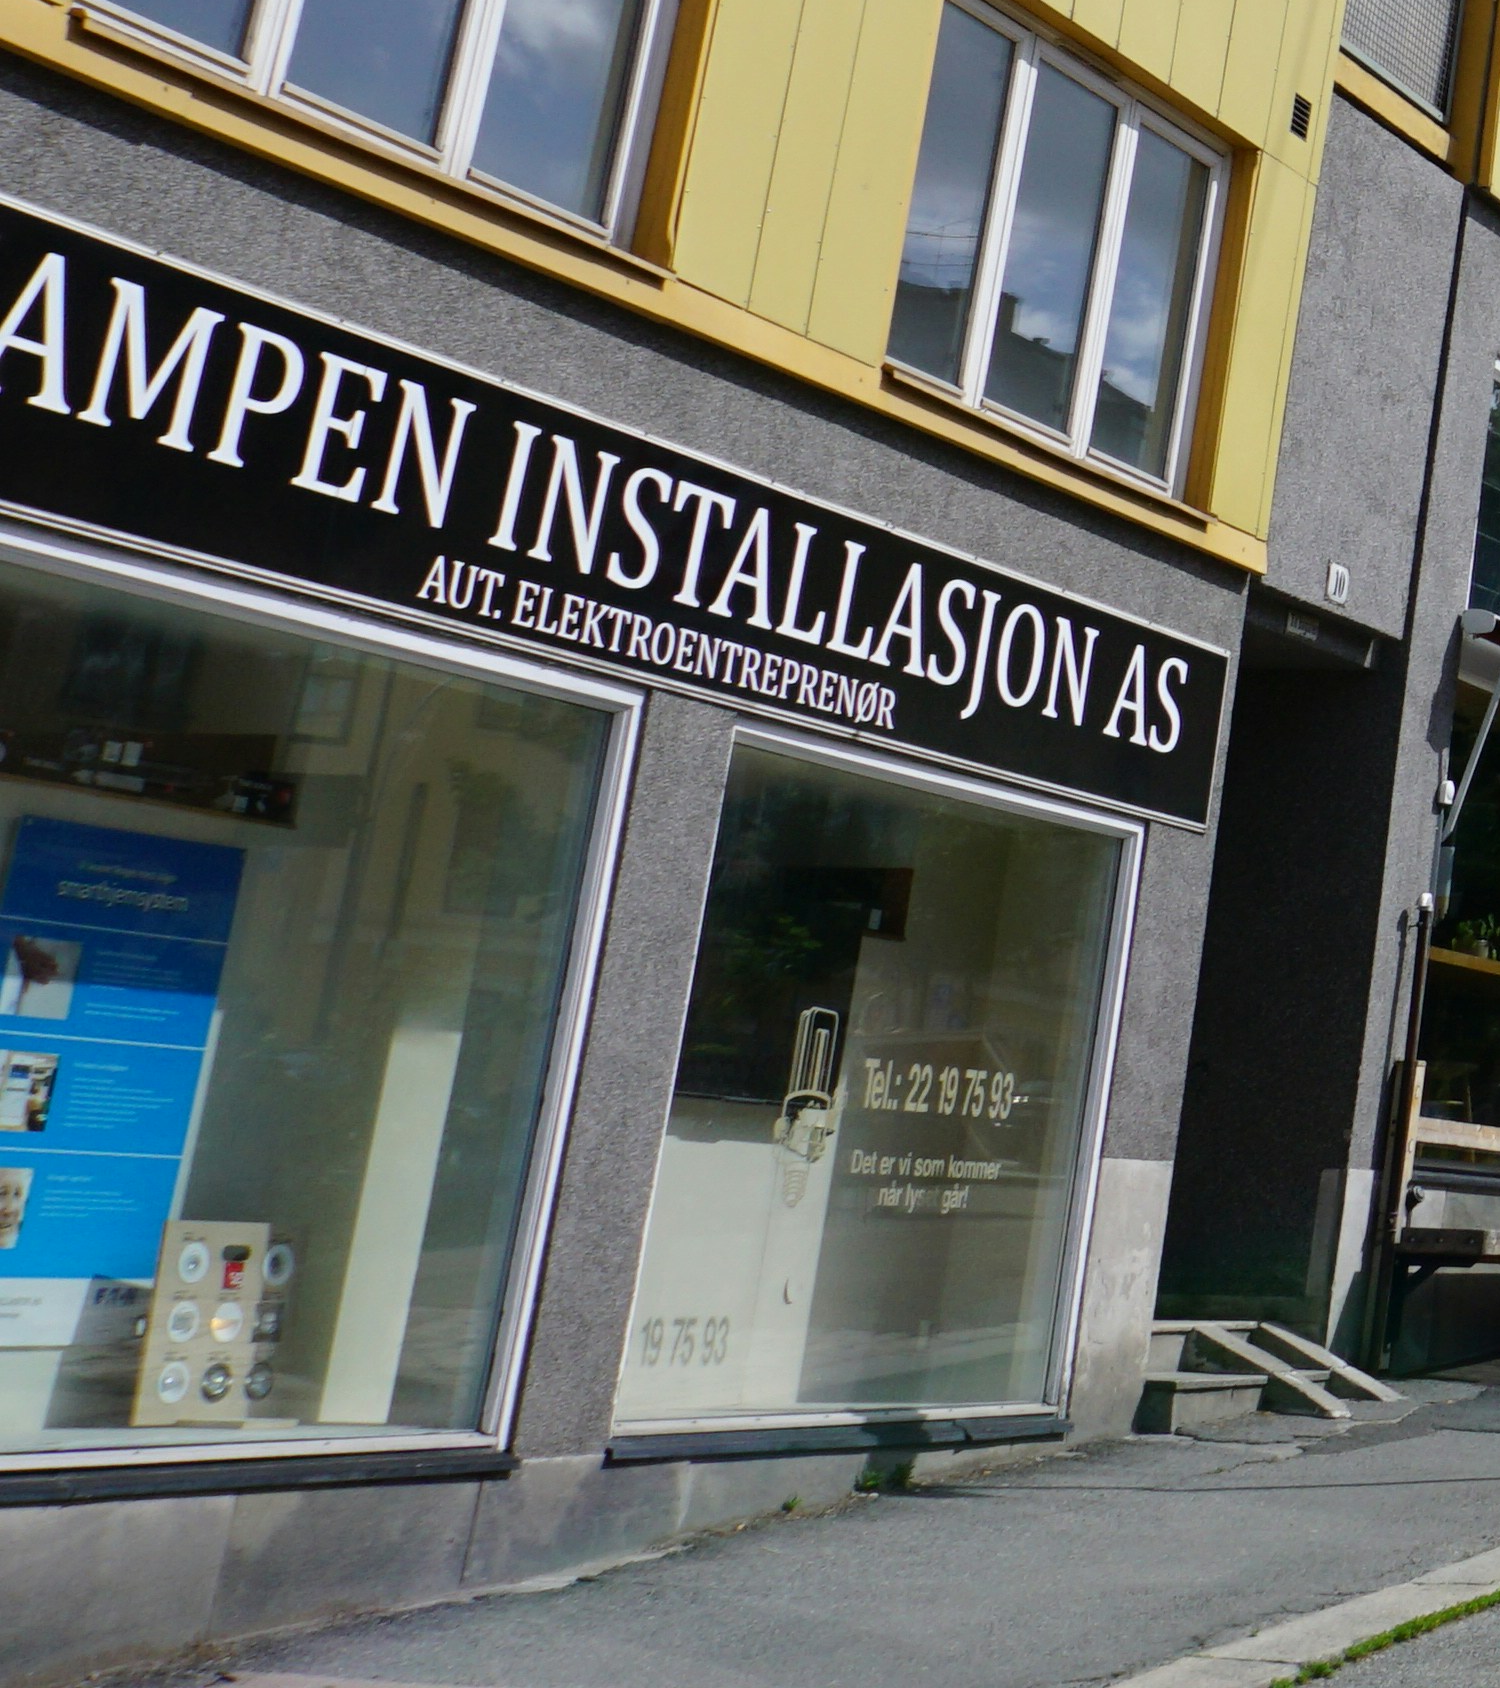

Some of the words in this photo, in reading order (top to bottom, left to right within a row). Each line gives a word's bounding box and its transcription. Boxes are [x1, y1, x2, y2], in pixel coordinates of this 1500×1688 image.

[487, 420, 1099, 726] INSTALLASJON
[1103, 644, 1188, 753] AS
[1333, 570, 1346, 598] 10
[416, 555, 505, 619] AUT.
[511, 580, 896, 730] ELEKTROENTREPRENØR
[864, 1058, 902, 1110] Tel.:
[904, 1063, 933, 1112] 22
[937, 1065, 959, 1115] 19
[961, 1068, 987, 1117] 75
[988, 1072, 1015, 1119] 93
[850, 1149, 878, 1174] Det
[879, 1157, 894, 1175] er
[899, 1152, 913, 1176] vi
[914, 1158, 945, 1177] som
[948, 1155, 1001, 1180] kommer
[877, 1180, 904, 1206] når
[941, 1183, 970, 1214] går!
[640, 1316, 664, 1367] 19
[669, 1316, 698, 1367] 75
[702, 1315, 730, 1367] 93
